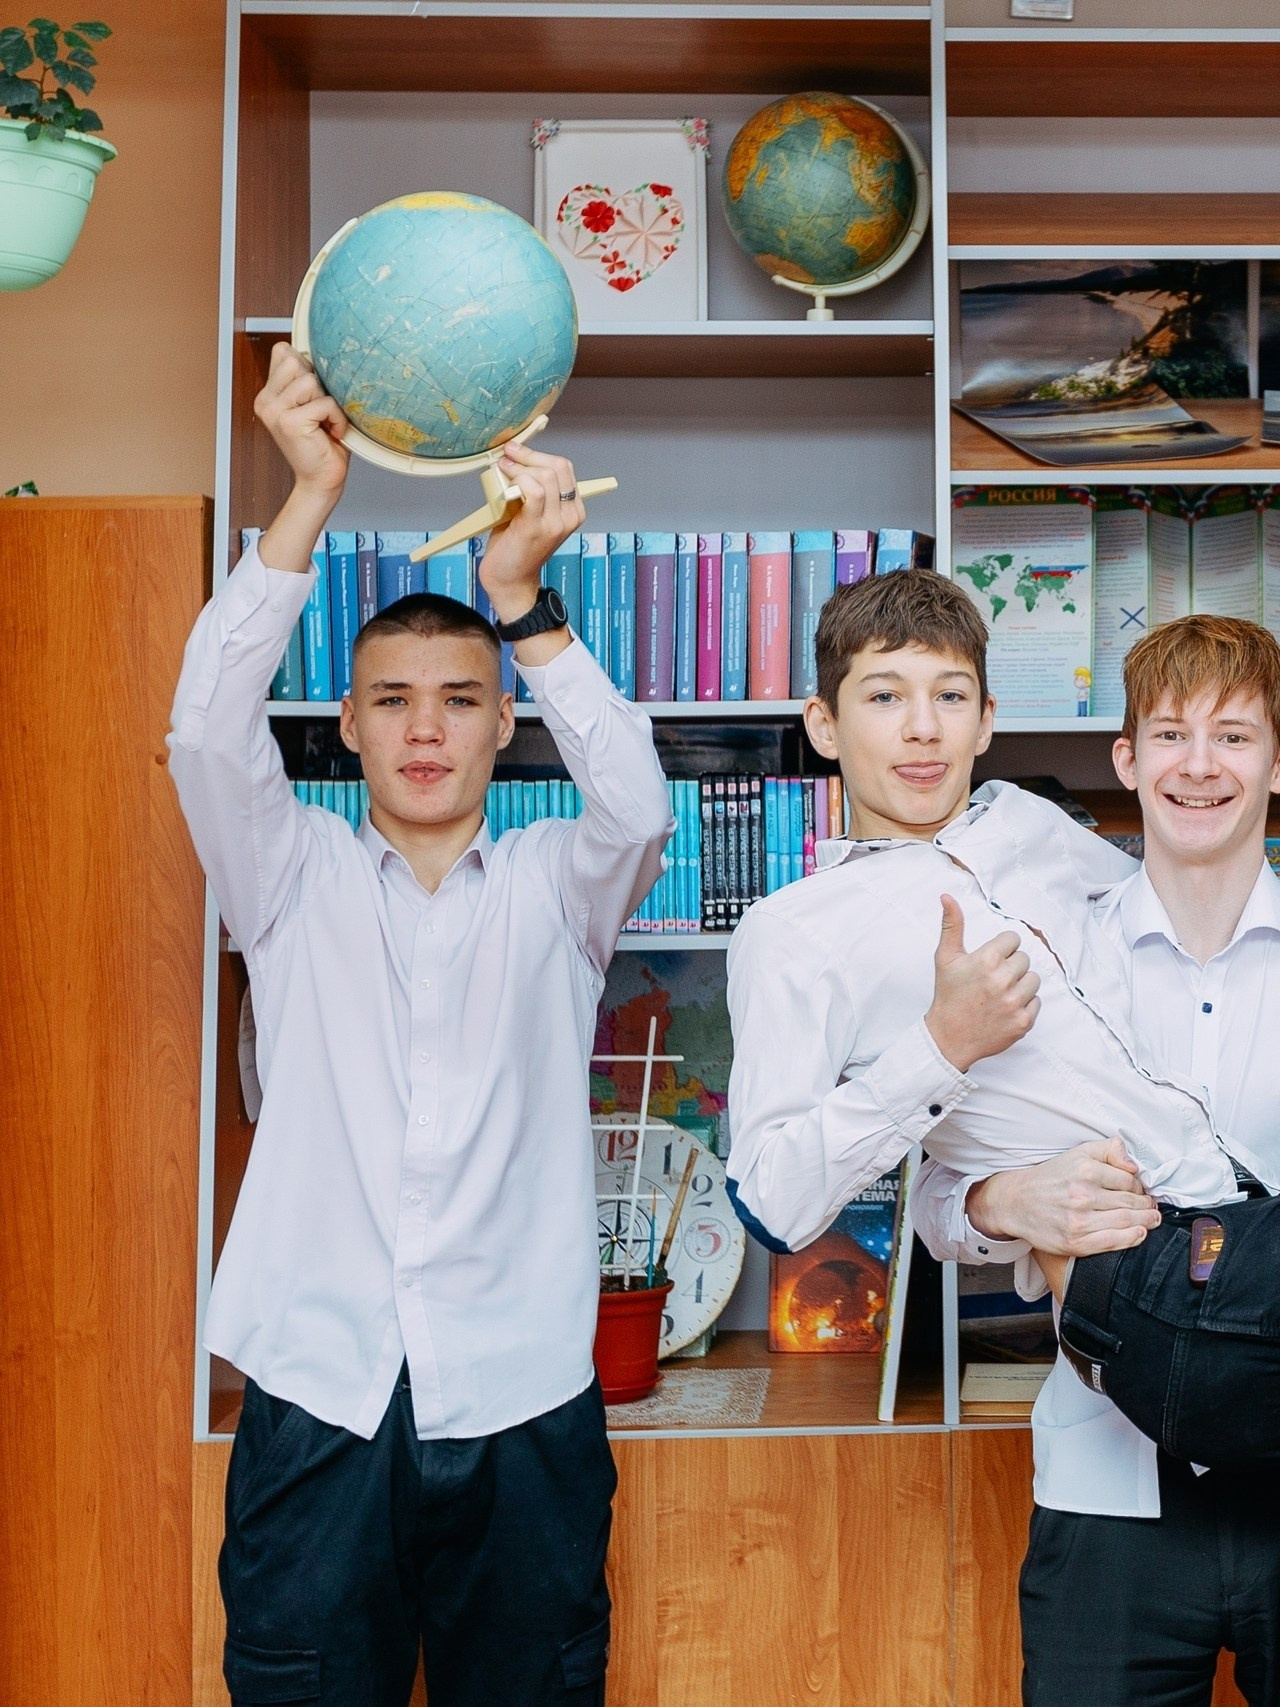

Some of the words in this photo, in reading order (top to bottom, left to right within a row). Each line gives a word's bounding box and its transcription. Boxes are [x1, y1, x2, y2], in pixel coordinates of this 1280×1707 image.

[987, 488, 1057, 502] РОССИЯ
[607, 1130, 639, 1162] 12
[663, 1142, 673, 1175] 1
[690, 1174, 714, 1208] 2
[854, 1190, 897, 1202] ТЕМА
[867, 1179, 900, 1191] НАЯ
[696, 1223, 722, 1258] 3
[681, 1268, 710, 1304] 4
